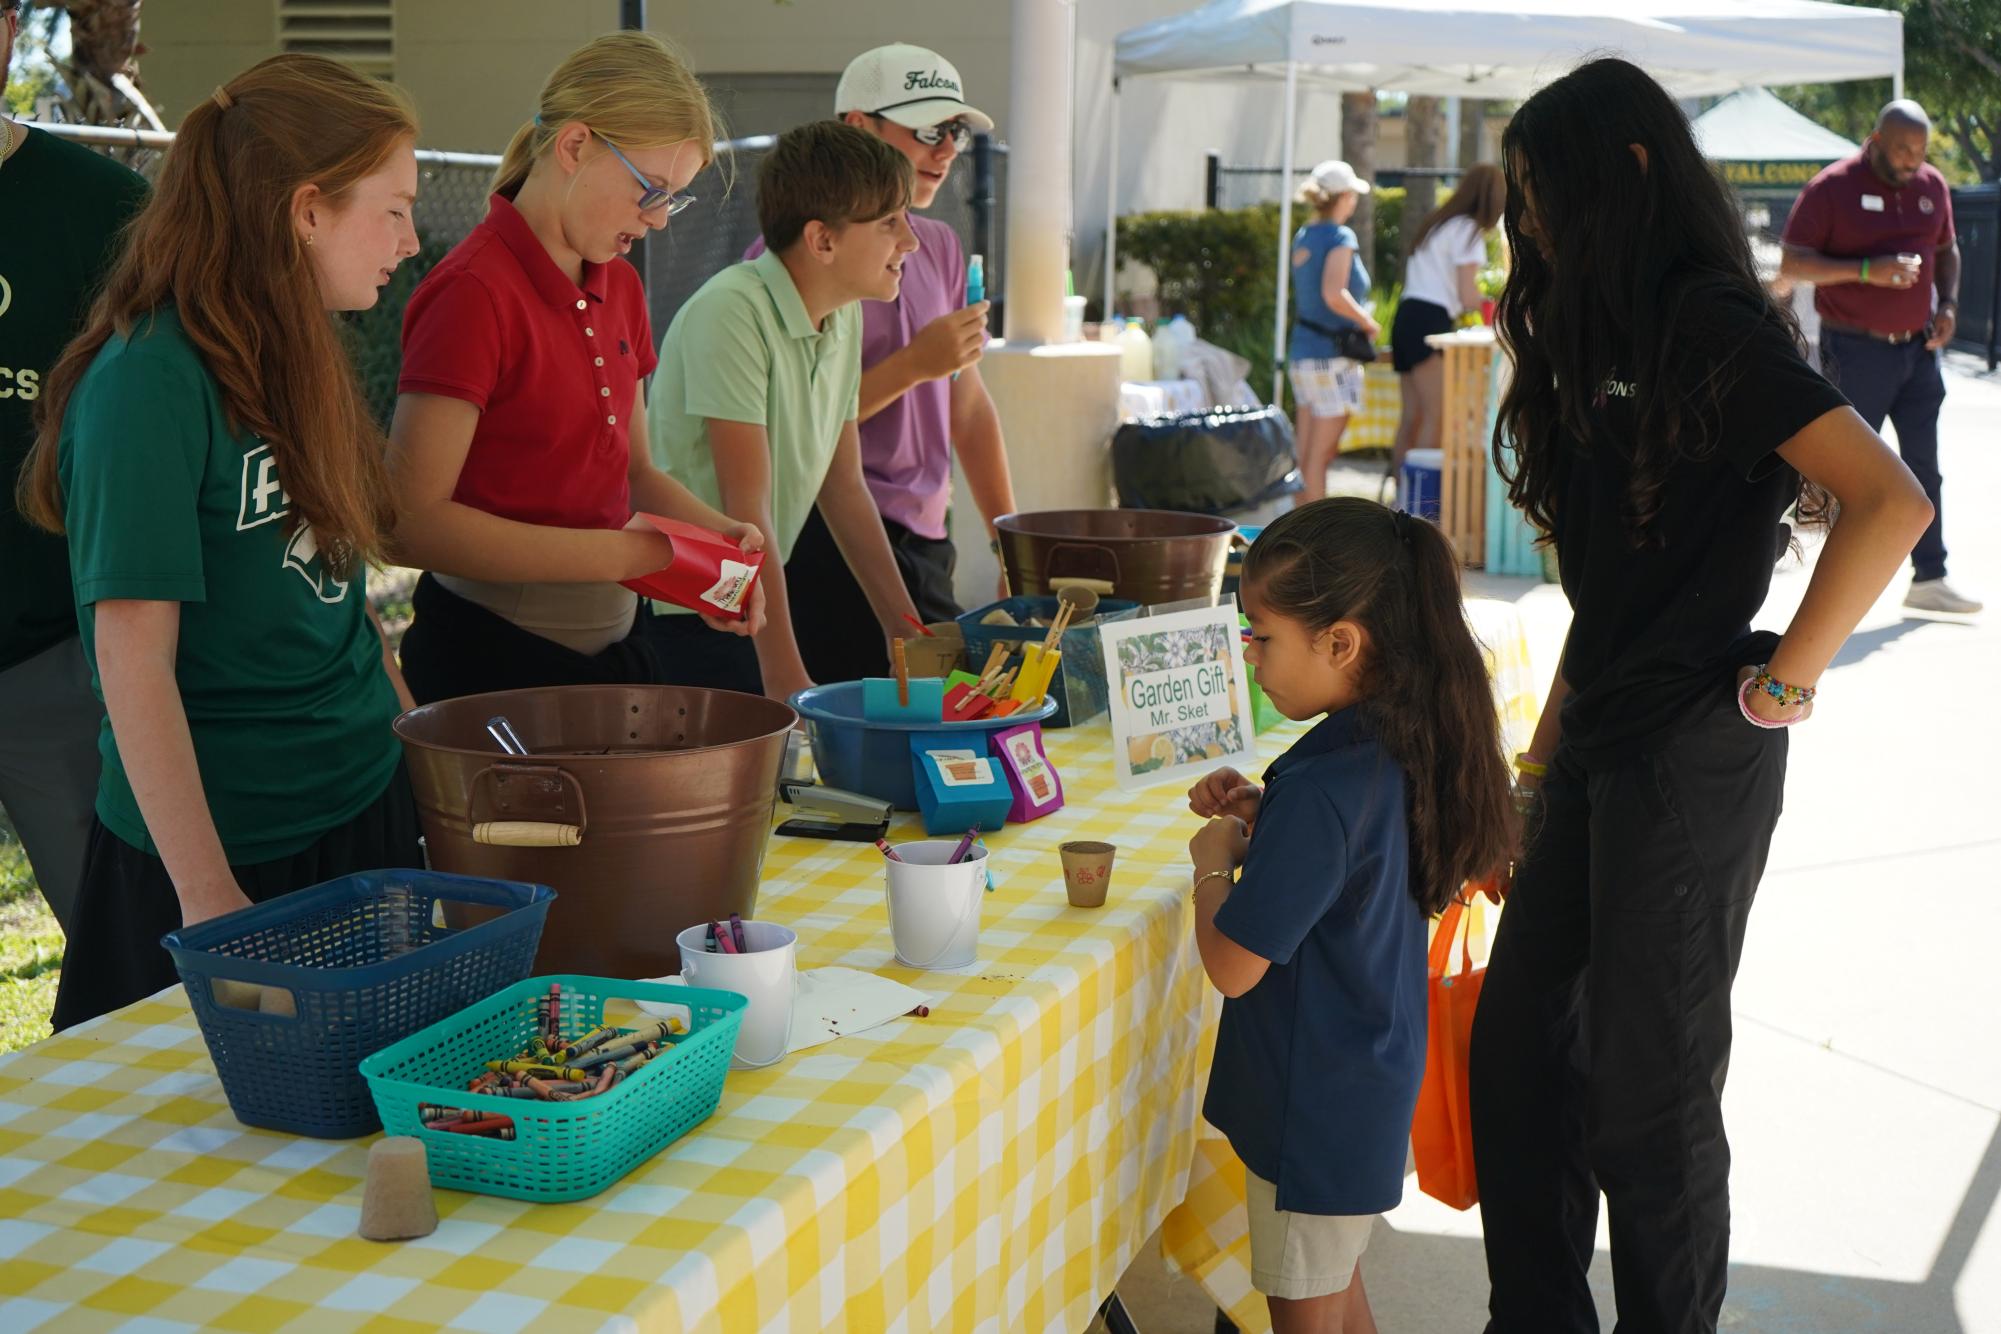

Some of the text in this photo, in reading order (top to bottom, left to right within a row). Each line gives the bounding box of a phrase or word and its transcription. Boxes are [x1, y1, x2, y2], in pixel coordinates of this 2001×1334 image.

[1131, 665, 1227, 709] Garden Gift
[1150, 703, 1209, 727] Mr. Sket
